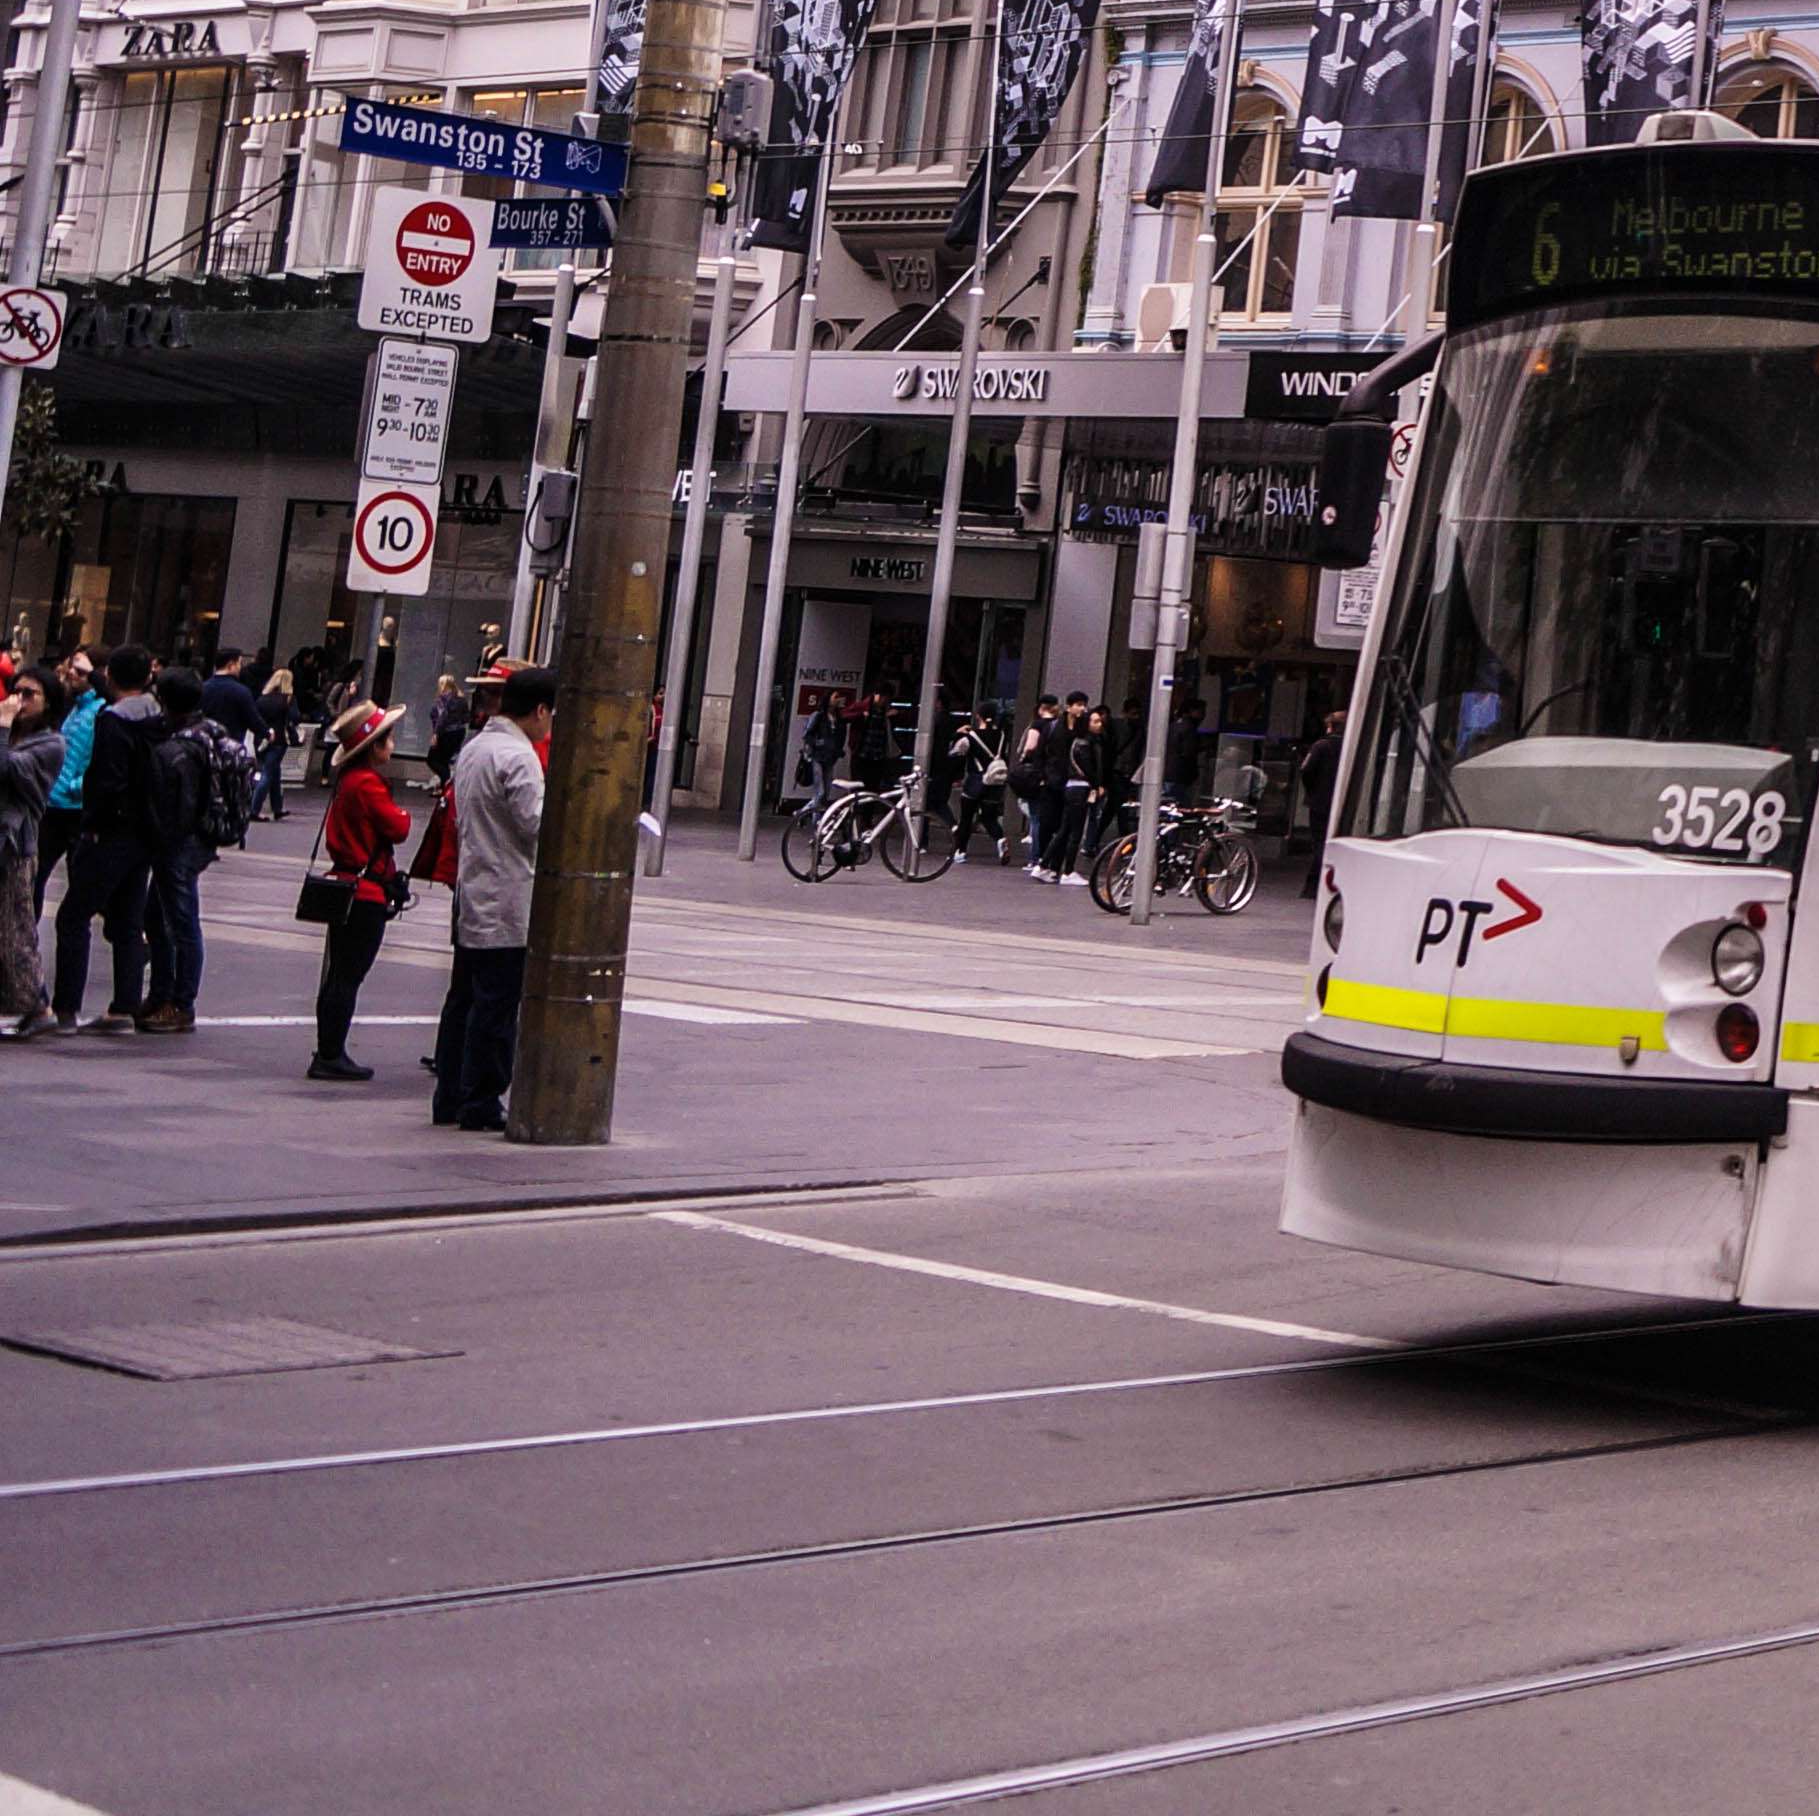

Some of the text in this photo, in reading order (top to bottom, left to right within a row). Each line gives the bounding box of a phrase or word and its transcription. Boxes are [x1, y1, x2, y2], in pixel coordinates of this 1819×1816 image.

[121, 20, 223, 56] ZARA
[353, 103, 545, 164] Swanston St
[457, 151, 541, 179] 135 173
[427, 213, 451, 232] NO
[497, 201, 587, 231] Bourke St
[530, 231, 584, 245] 357 271
[1531, 202, 1561, 284] 6
[1612, 197, 1803, 235] Melbourne
[406, 253, 462, 276] ENTRY
[1589, 246, 1641, 279] via
[400, 287, 462, 311] TRAMS
[380, 307, 473, 335] EXCEPTED
[382, 393, 401, 406] MID
[851, 557, 925, 581] NINE WEST
[800, 668, 863, 682] NINE WEST
[1652, 785, 1786, 855] 3528
[1416, 898, 1493, 968] PT
